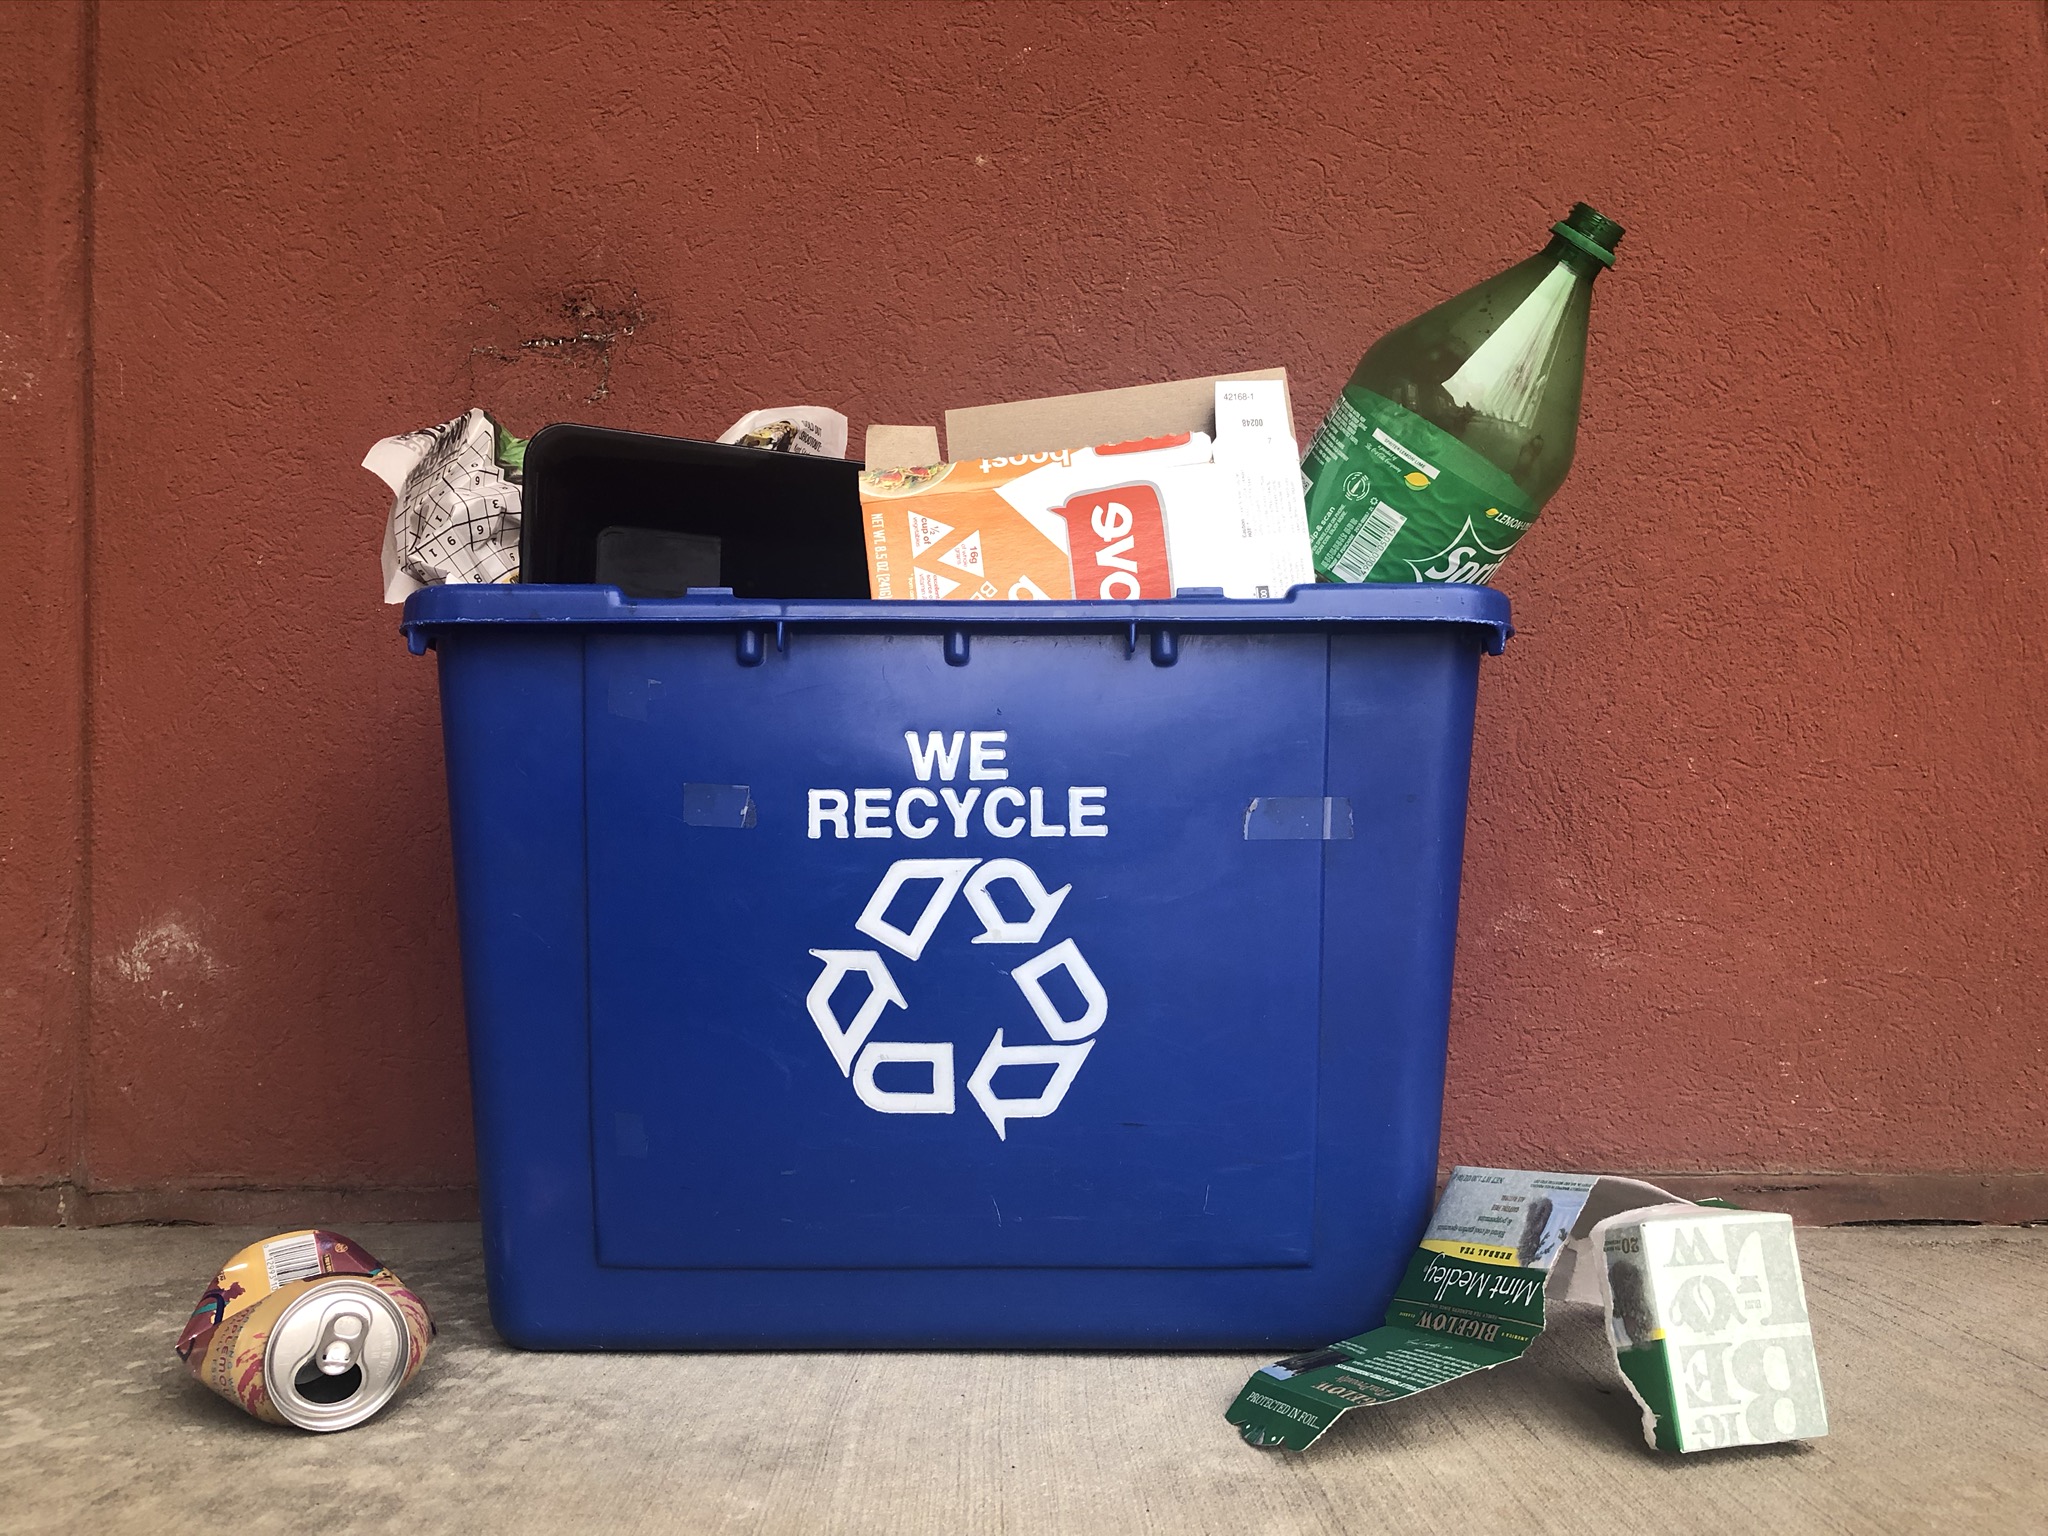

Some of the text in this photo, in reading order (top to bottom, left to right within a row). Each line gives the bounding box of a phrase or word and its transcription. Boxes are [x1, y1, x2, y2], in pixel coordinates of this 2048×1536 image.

[1242, 418, 1263, 427] 00248
[492, 499, 499, 509] 3
[871, 513, 884, 528] NET
[1315, 523, 1324, 533] &
[1320, 505, 1336, 526] scan
[921, 518, 931, 545] cup of
[1339, 533, 1355, 554] PURCHASE
[1359, 550, 1380, 577] 49000
[1376, 526, 1397, 552] 05015
[875, 546, 888, 560] 8.5
[969, 546, 978, 564] 16g
[876, 561, 890, 573] OZ
[474, 573, 483, 583] 8
[904, 730, 1009, 781] WE
[807, 786, 1108, 839] RECYCLE
[1458, 1225, 1475, 1234] garden
[1490, 1229, 1506, 1239] Blend
[1460, 1246, 1513, 1260] HERBAL TEA
[1621, 1237, 1639, 1254] 20
[1423, 1251, 1540, 1306] Mint Medley
[1415, 1309, 1501, 1343] BIGELOW
[1246, 1391, 1290, 1415] PROTECTED
[1287, 1407, 1302, 1419] IN
